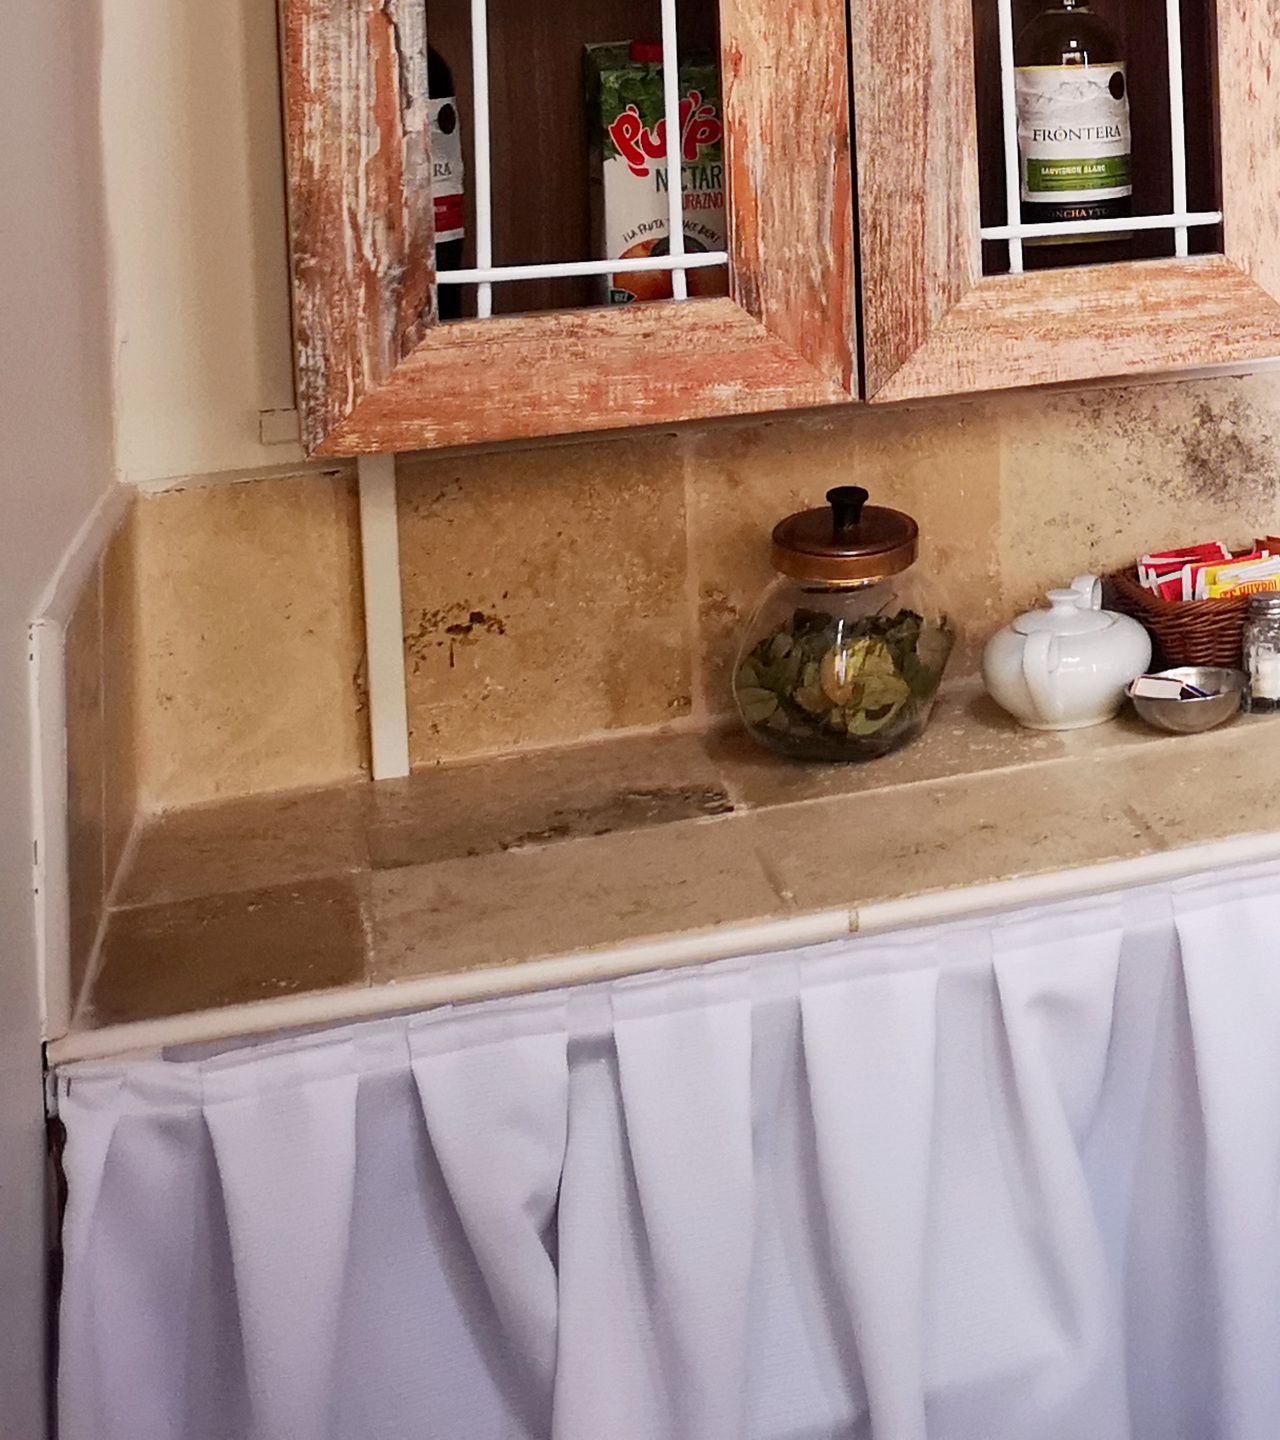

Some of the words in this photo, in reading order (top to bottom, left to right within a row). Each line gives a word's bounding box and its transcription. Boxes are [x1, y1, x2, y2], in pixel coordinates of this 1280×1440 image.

[1032, 125, 1122, 142] FRONTERA
[655, 165, 722, 192] NCTAR
[682, 191, 723, 210] URAZNO
